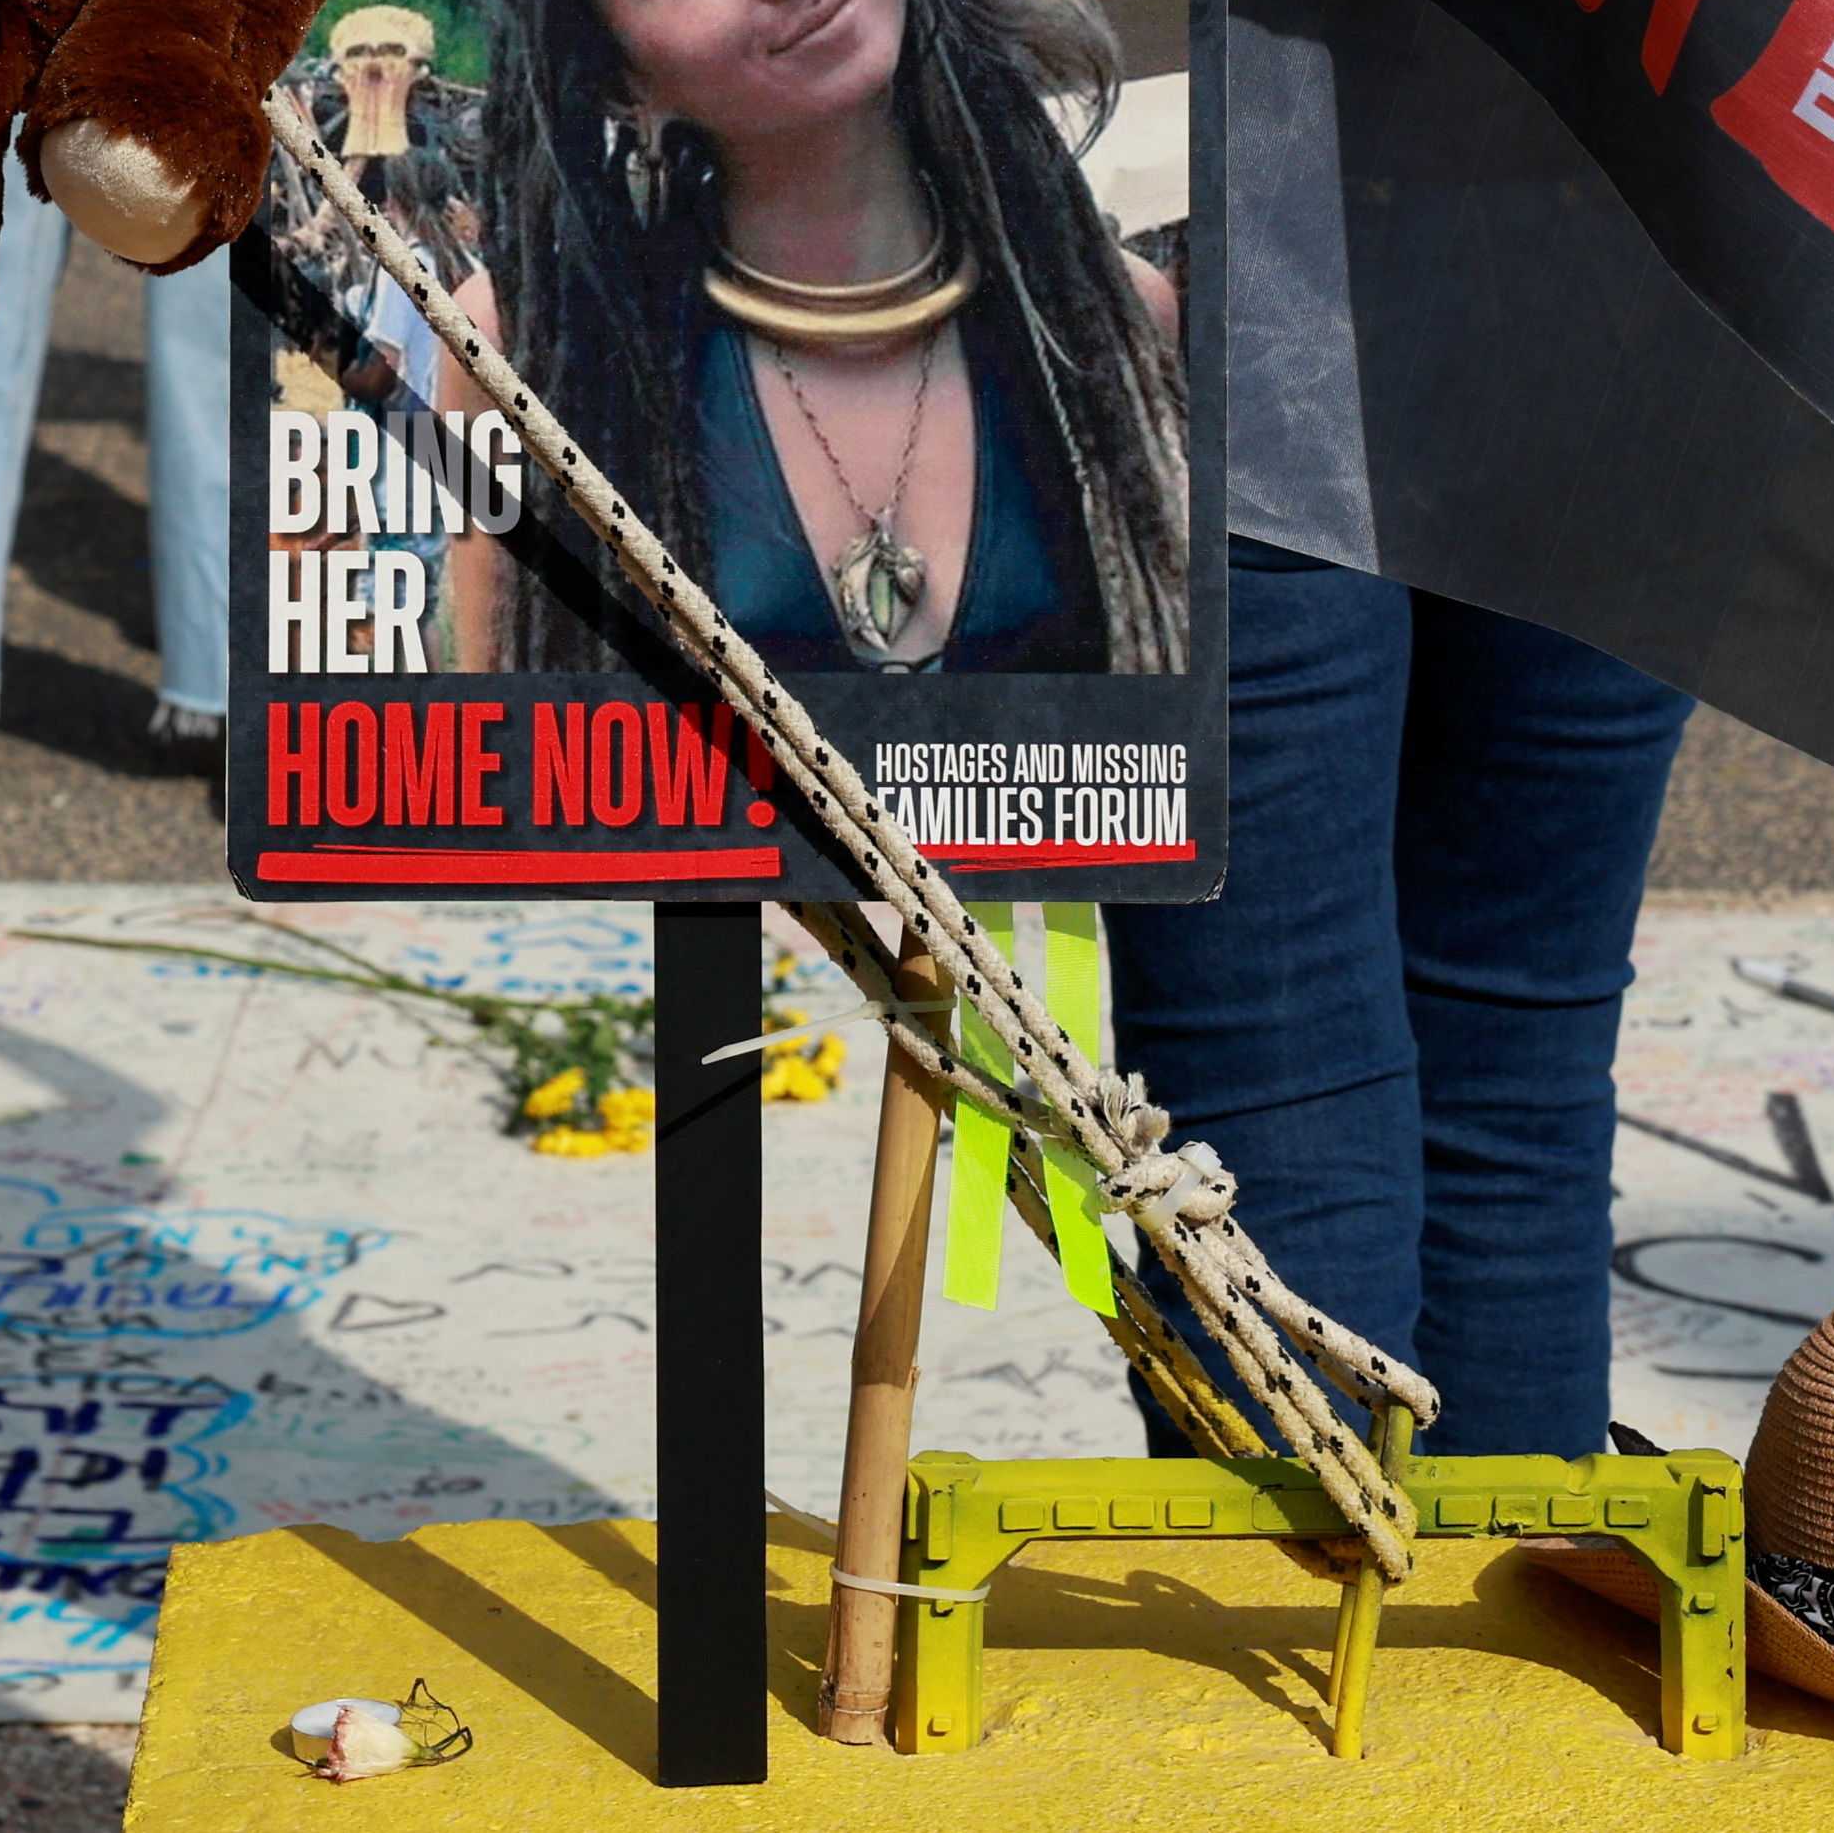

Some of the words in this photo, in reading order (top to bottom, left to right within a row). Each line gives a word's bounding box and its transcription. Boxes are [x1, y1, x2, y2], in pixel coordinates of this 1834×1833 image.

[268, 409, 523, 536] BRING
[268, 548, 429, 675] HER
[267, 701, 504, 827] HOME
[532, 701, 777, 828] NOW!
[875, 743, 1007, 784] HOSTAGES
[1012, 744, 1065, 784] AND
[1071, 743, 1187, 784] MISSING
[876, 787, 1045, 846] FAMILIES
[1054, 787, 1187, 846] FORUM
